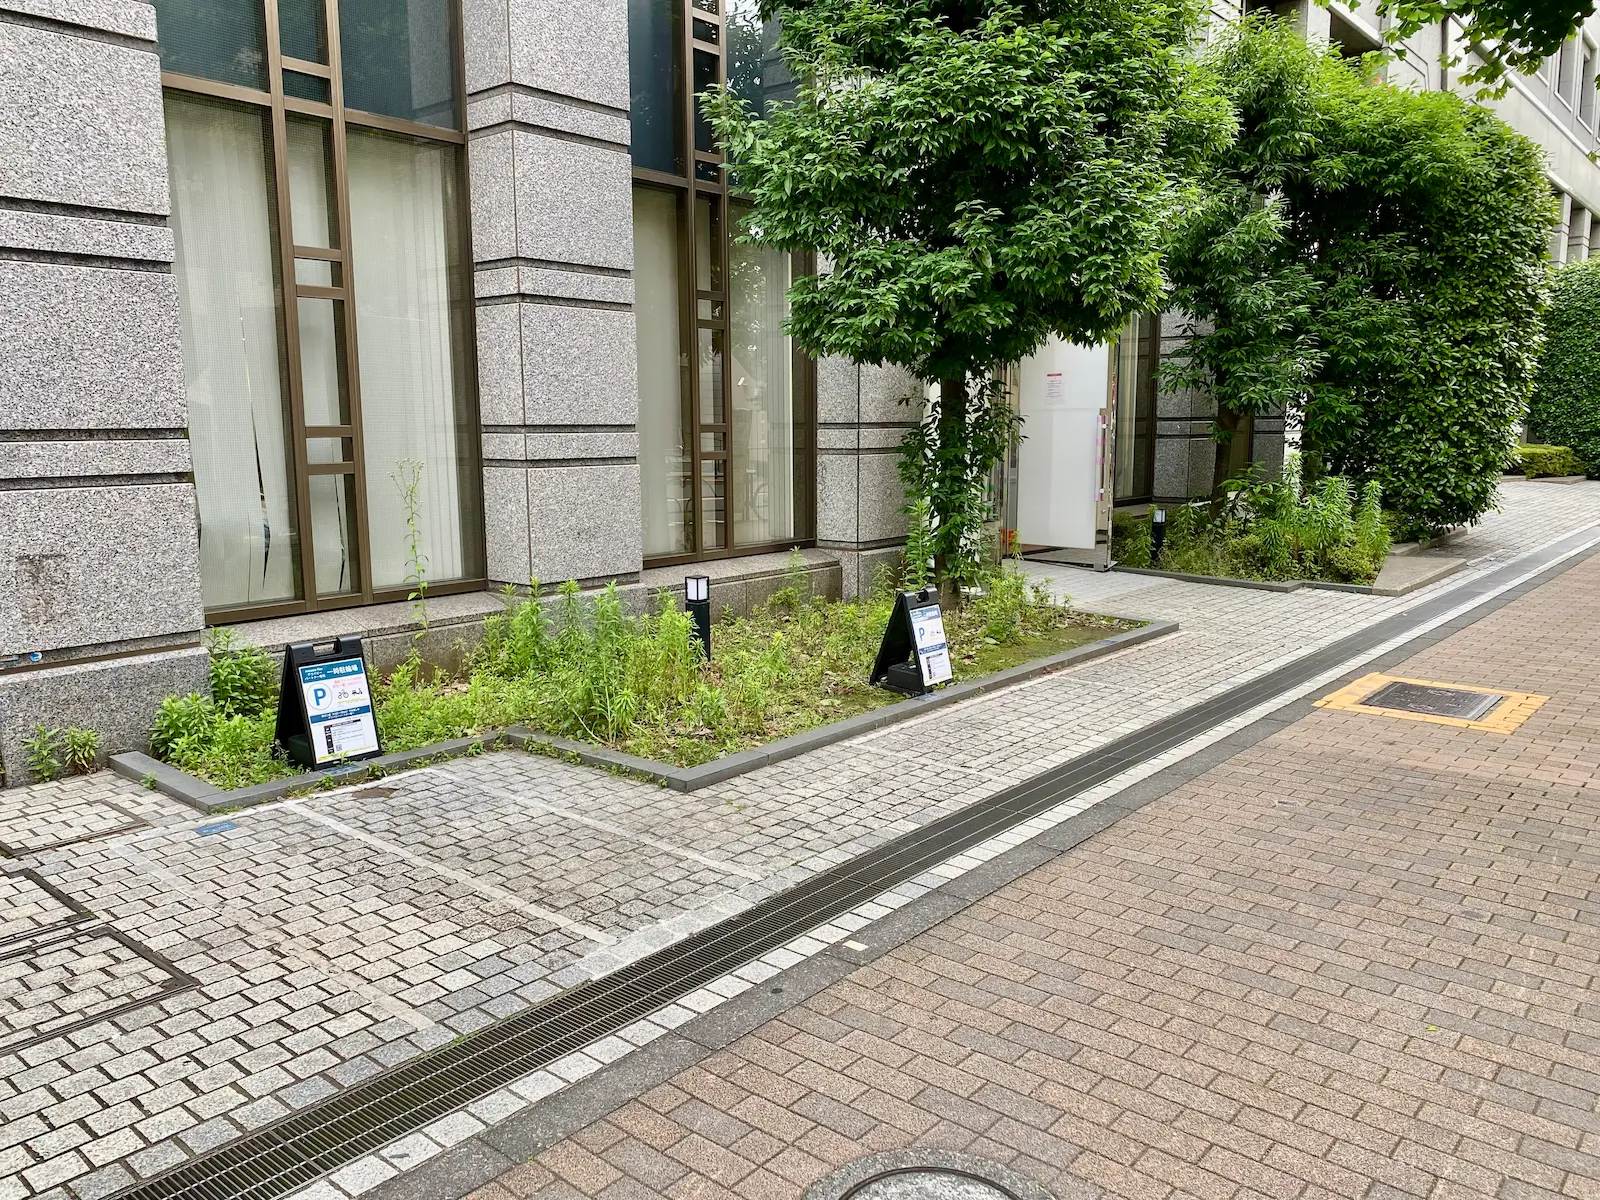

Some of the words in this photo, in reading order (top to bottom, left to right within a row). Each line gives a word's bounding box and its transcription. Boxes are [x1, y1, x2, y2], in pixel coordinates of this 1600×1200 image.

[919, 627, 925, 641] P
[327, 664, 358, 675] 一時駐輪場
[313, 687, 327, 706] P
